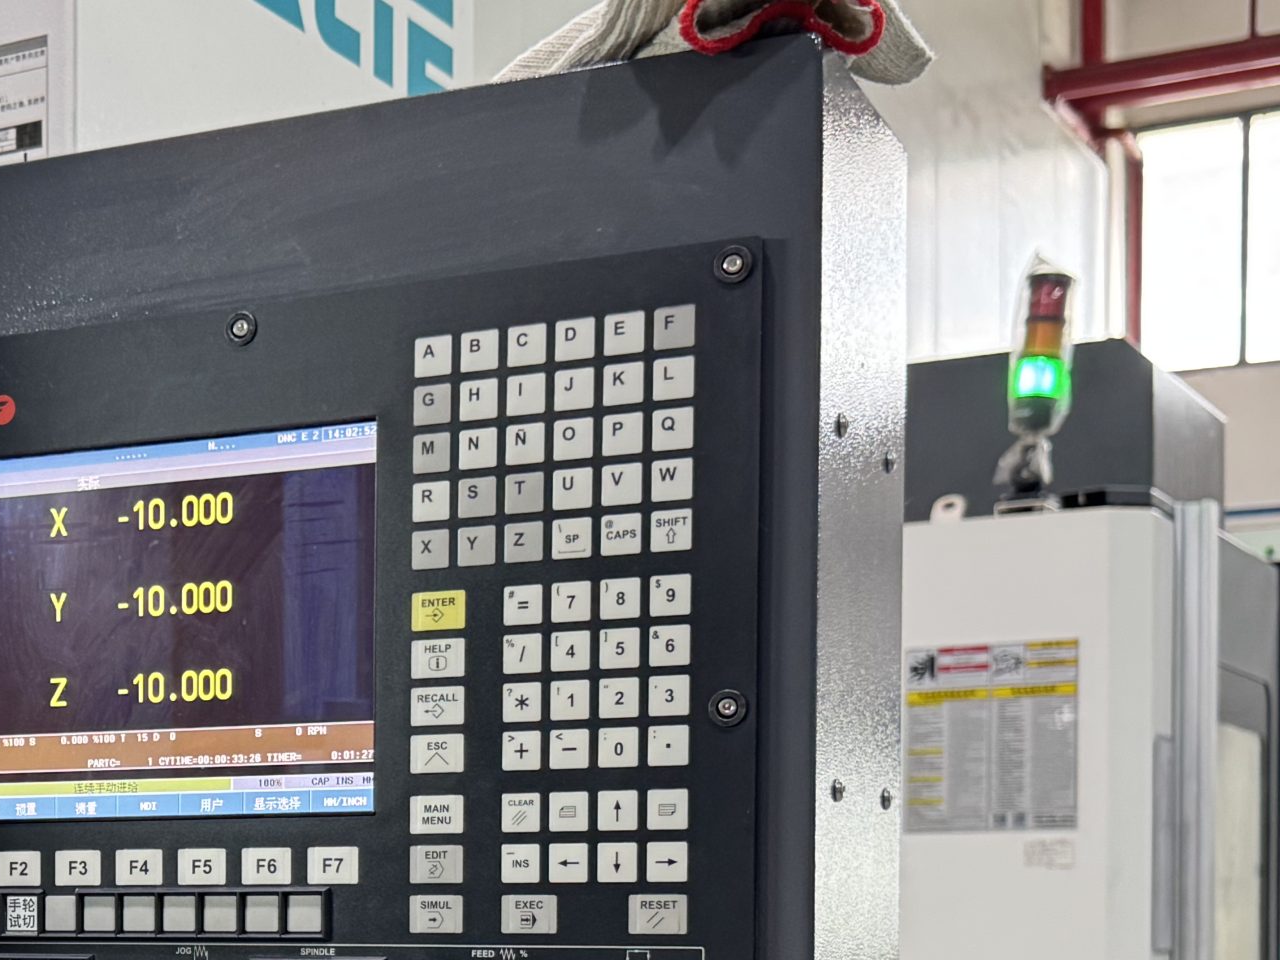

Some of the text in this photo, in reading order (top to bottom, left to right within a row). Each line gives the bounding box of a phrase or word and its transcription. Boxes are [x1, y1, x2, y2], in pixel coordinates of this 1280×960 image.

[614, 321, 625, 335] E
[665, 315, 674, 330] F
[517, 333, 527, 347] C
[565, 327, 576, 341] D
[423, 345, 434, 358] A
[470, 339, 480, 353] B
[613, 371, 624, 386] K
[664, 366, 674, 380] L
[519, 383, 522, 396] I
[564, 377, 573, 391] J
[423, 393, 434, 406] G
[469, 388, 479, 401] H
[613, 422, 623, 436] P
[661, 417, 675, 431] Q
[278, 432, 319, 443] DNC E 2
[328, 427, 376, 439] 14:02:52
[515, 429, 526, 445] Ñ
[563, 427, 575, 441] O
[422, 441, 434, 455] M
[469, 436, 478, 450] N
[611, 472, 623, 486] V
[659, 467, 676, 481] W
[515, 481, 525, 495] T
[563, 476, 573, 490] U
[422, 490, 432, 503] R
[468, 485, 478, 499] S
[50, 492, 233, 537] X -10.000
[656, 516, 688, 527] SHIFT
[514, 533, 524, 546] Z
[565, 534, 579, 543] SP
[606, 529, 636, 540] CAPS
[421, 540, 431, 554] X
[467, 536, 477, 550] Y
[50, 580, 233, 622] Y -10.000
[422, 597, 455, 607] ENTER
[567, 595, 575, 609] 7
[616, 592, 625, 605] 8
[666, 588, 675, 602] 9
[425, 644, 451, 653] HELP
[566, 645, 575, 658] 4
[616, 642, 624, 655] 5
[666, 639, 675, 652] 6
[50, 668, 233, 706] Z -10.000
[417, 693, 458, 702] RECALL
[568, 694, 573, 707] 1
[615, 691, 624, 705] 2
[665, 689, 674, 702] 3
[61, 736, 88, 744] 0.000
[92, 735, 115, 743] %100
[137, 733, 148, 742] 15
[308, 727, 326, 735] RPM
[427, 741, 447, 750] ESC
[615, 742, 623, 756] 0
[88, 759, 120, 767] PARTC=
[267, 753, 302, 762] TIMER=
[331, 750, 374, 759] 0:01:27
[74, 782, 138, 794] 连续手动进给
[259, 779, 281, 787] 100%
[312, 777, 353, 786] CAP INS
[76, 801, 97, 815] 测量
[140, 802, 158, 810] MDI
[200, 799, 223, 812] 用户
[253, 797, 302, 810] 显示选择
[324, 797, 367, 806] MM/INCH
[424, 805, 449, 813] MAIN
[422, 816, 451, 824] MENU
[425, 851, 448, 859] EDIT
[10, 862, 28, 876] F2
[69, 861, 87, 875] F3
[130, 860, 149, 875] F4
[192, 859, 212, 874] F5
[257, 859, 276, 873] F6
[323, 858, 343, 873] F7
[513, 860, 529, 868] INS
[9, 899, 35, 913] 手轮
[420, 901, 452, 909] SIMUL
[515, 901, 543, 909] EXEC
[641, 901, 678, 909] RESET
[9, 914, 35, 929] 试切
